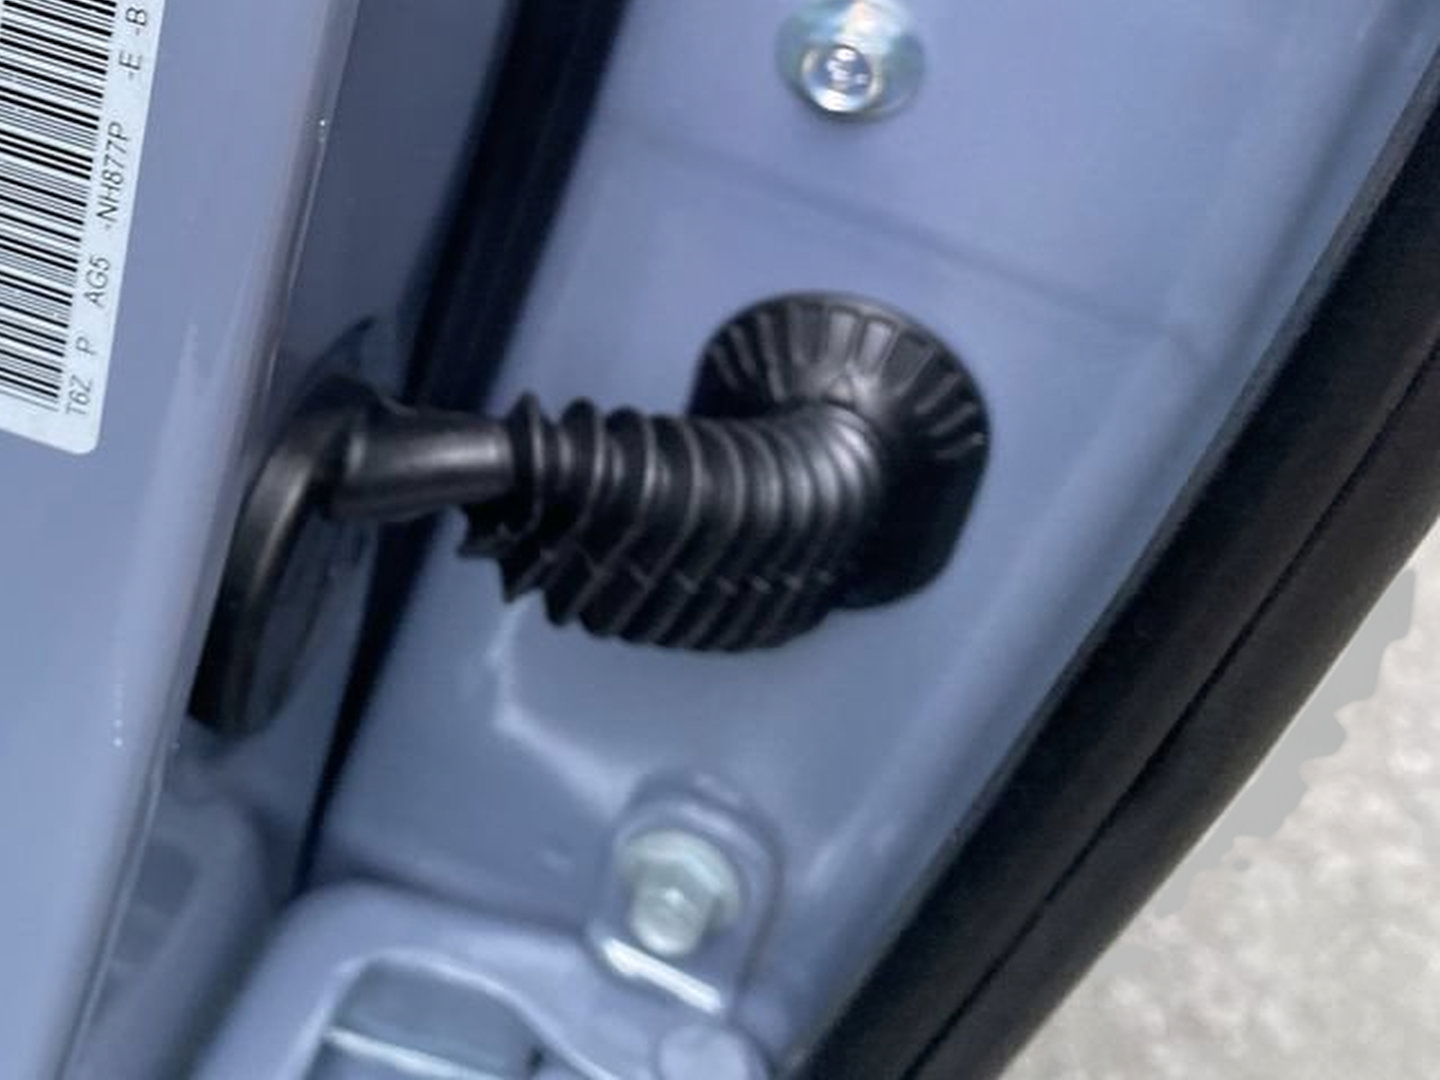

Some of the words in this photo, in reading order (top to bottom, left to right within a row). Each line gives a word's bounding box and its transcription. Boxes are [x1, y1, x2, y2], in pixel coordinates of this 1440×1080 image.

[82, 254, 111, 308] AG5
[74, 335, 96, 356] P
[64, 373, 93, 415] T6Z
